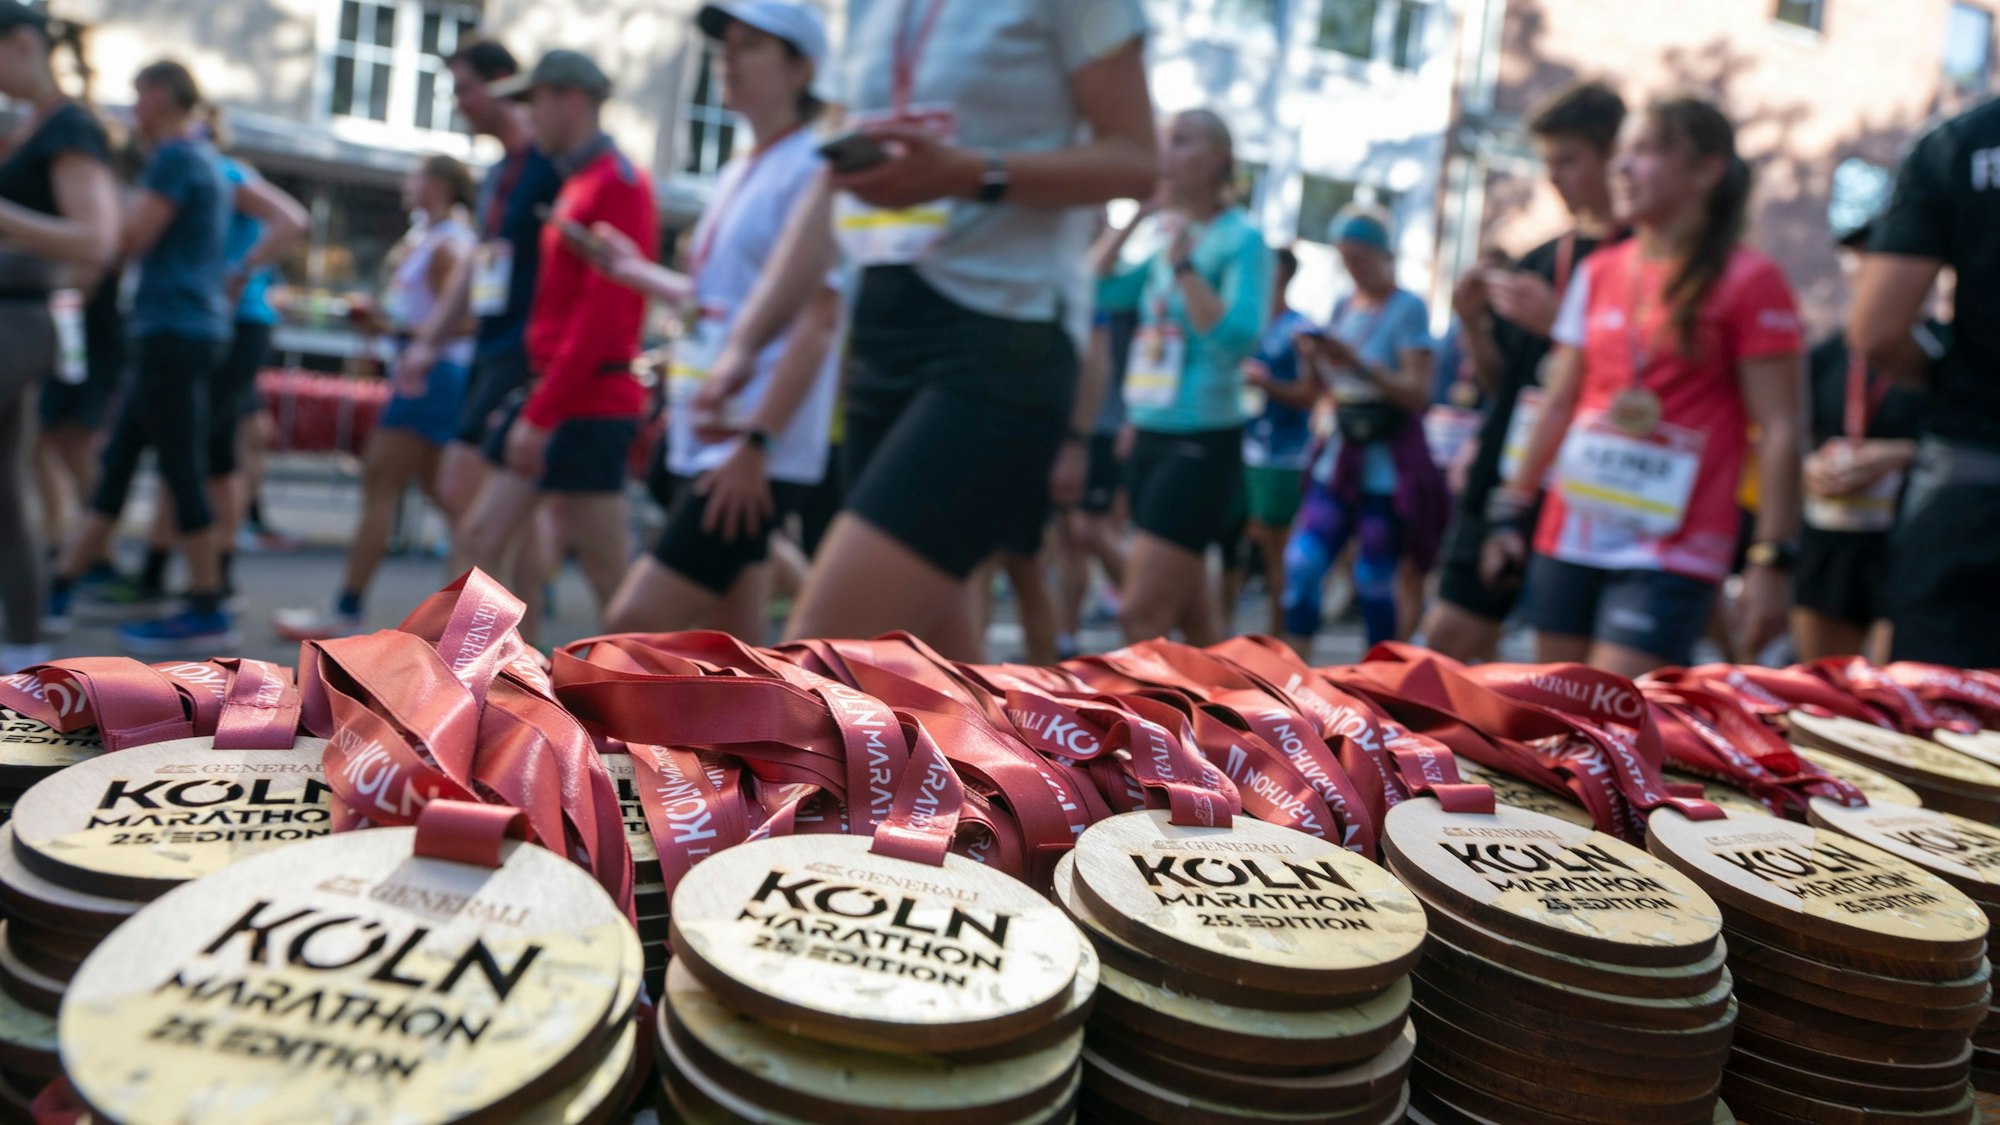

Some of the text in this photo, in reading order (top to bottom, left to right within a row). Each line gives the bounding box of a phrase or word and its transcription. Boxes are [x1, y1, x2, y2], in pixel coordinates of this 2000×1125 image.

[201, 764, 325, 774] GENERAL
[1149, 733, 1175, 780] RALI
[862, 730, 895, 815] MARAT
[86, 809, 330, 830] MARATHO
[169, 829, 331, 844] EDITION
[1185, 840, 1296, 855] GENERALI
[848, 869, 981, 903] GENERALI
[1487, 875, 1672, 895] MARATHON
[1778, 872, 1921, 900] MARATHON
[1154, 891, 1378, 913] MARATHON
[1579, 898, 1681, 912] EDITION
[1197, 913, 1375, 931] 25. EDITION
[736, 908, 1002, 973] MARATHON
[806, 947, 970, 989] EDITION
[155, 968, 492, 1045] MARATHON
[217, 1024, 424, 1079] EDITION
